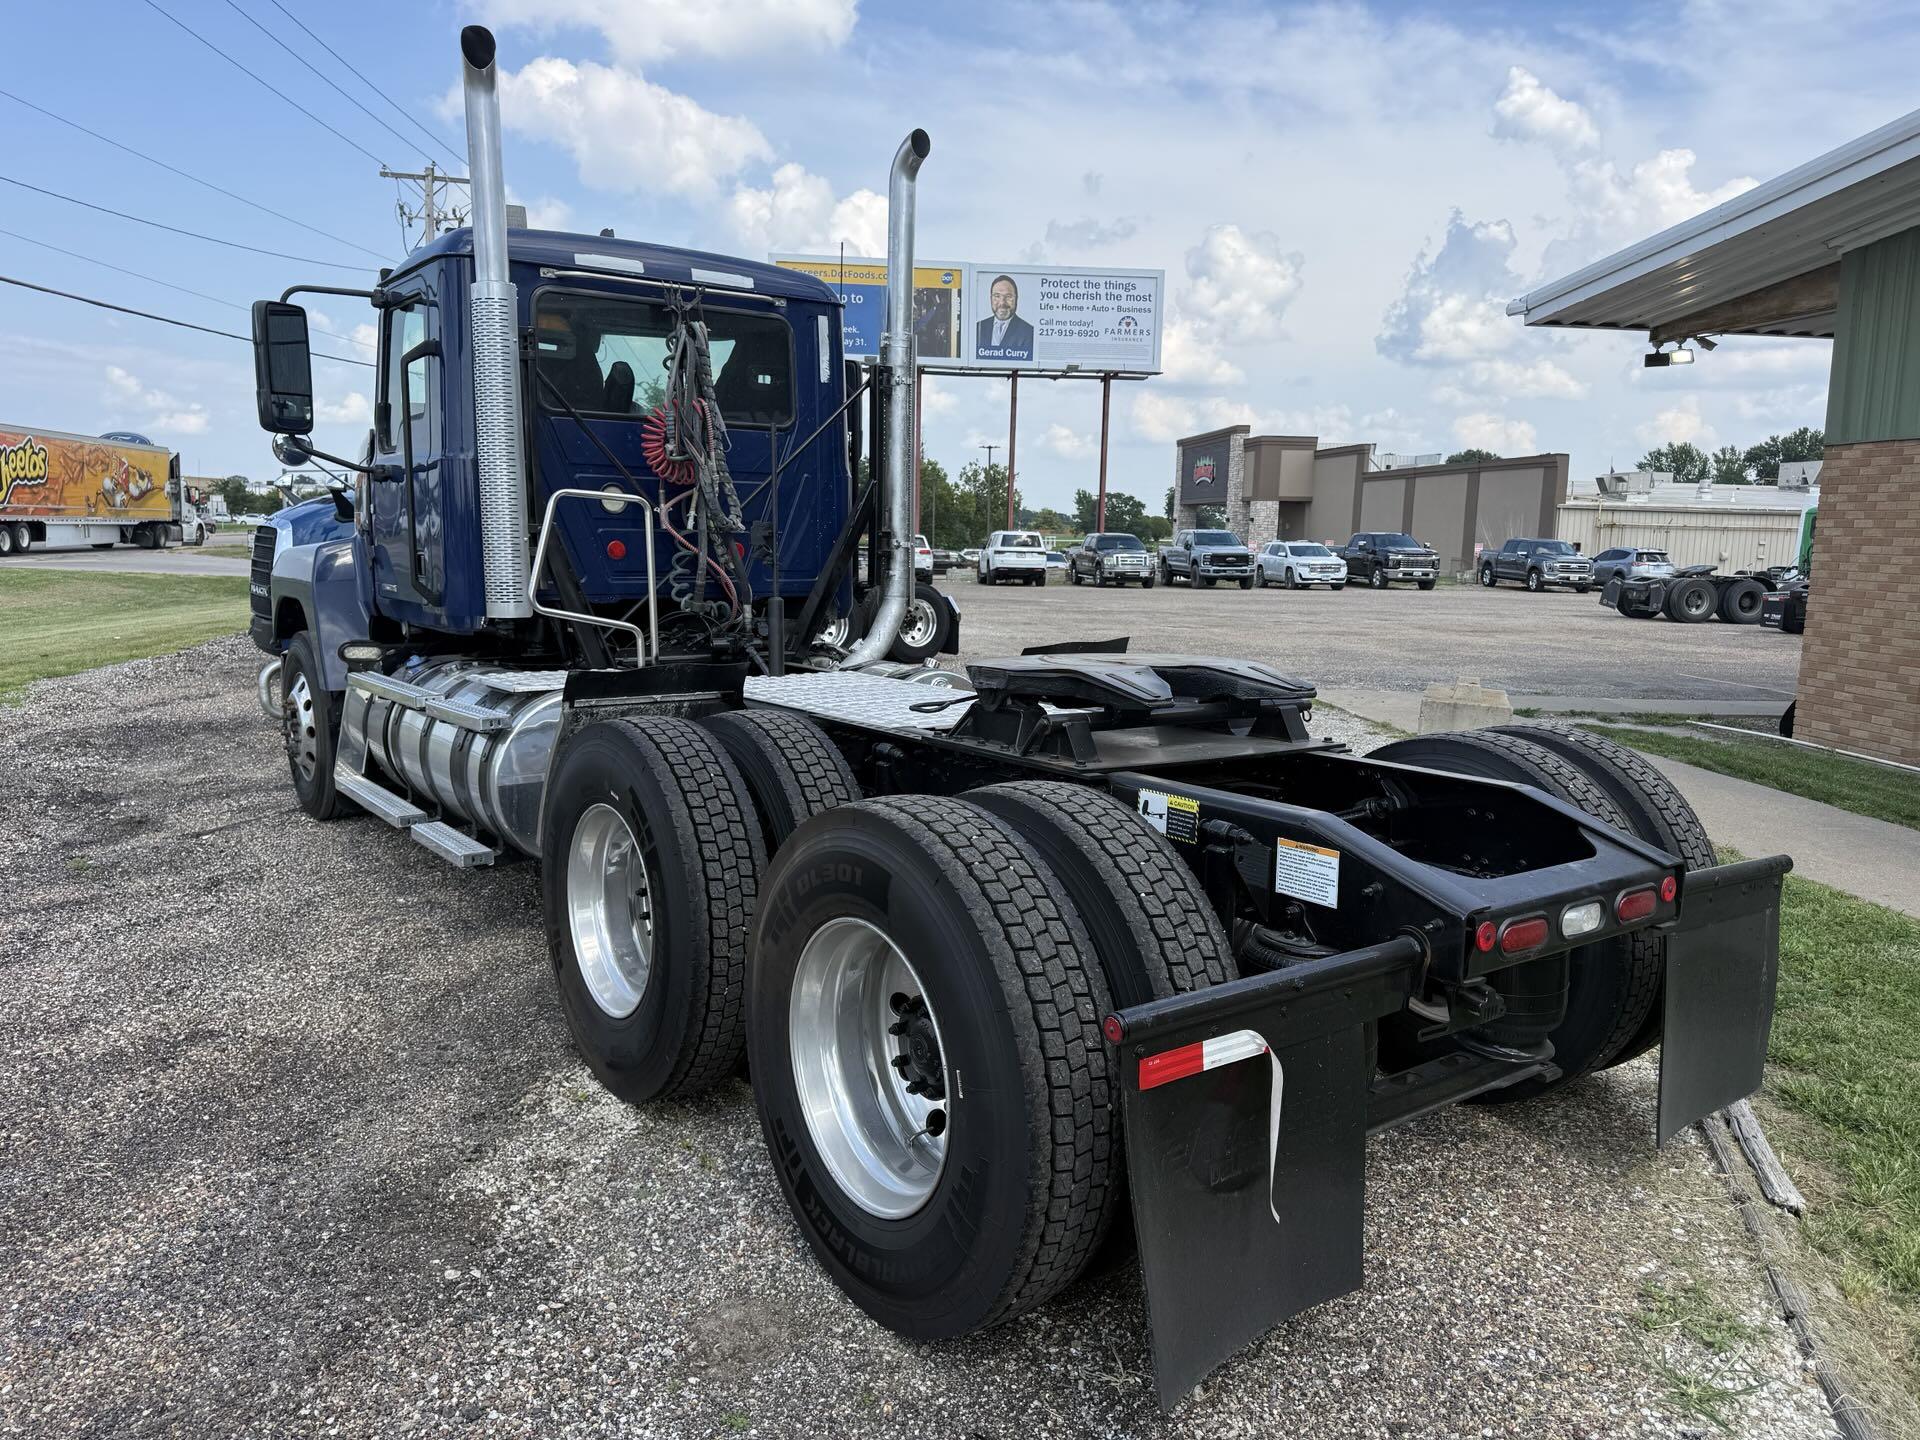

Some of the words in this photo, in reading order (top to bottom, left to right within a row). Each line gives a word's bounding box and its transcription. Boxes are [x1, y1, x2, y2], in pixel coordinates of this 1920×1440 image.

[1041, 278, 1080, 289] Protect
[1083, 279, 1101, 290] the
[1104, 280, 1137, 292] things
[850, 293, 864, 304] to
[1040, 291, 1059, 301] you
[1063, 290, 1101, 301] cherish
[1105, 292, 1122, 302] the
[1126, 293, 1152, 303] most
[1039, 303, 1054, 311] Life
[1061, 304, 1084, 312] Home
[1091, 305, 1110, 313] Auto
[1116, 305, 1152, 314] Business
[1039, 318, 1054, 326] Call
[1069, 319, 1094, 328] today!
[843, 325, 860, 334] eek.
[1039, 328, 1100, 338] 217-919-6920
[1104, 327, 1151, 336] FARMERS
[844, 338, 854, 347] ay
[855, 338, 867, 346] 31.
[978, 347, 1004, 357] Gerad
[1005, 348, 1029, 359] Curry
[0, 437, 47, 502] heetos
